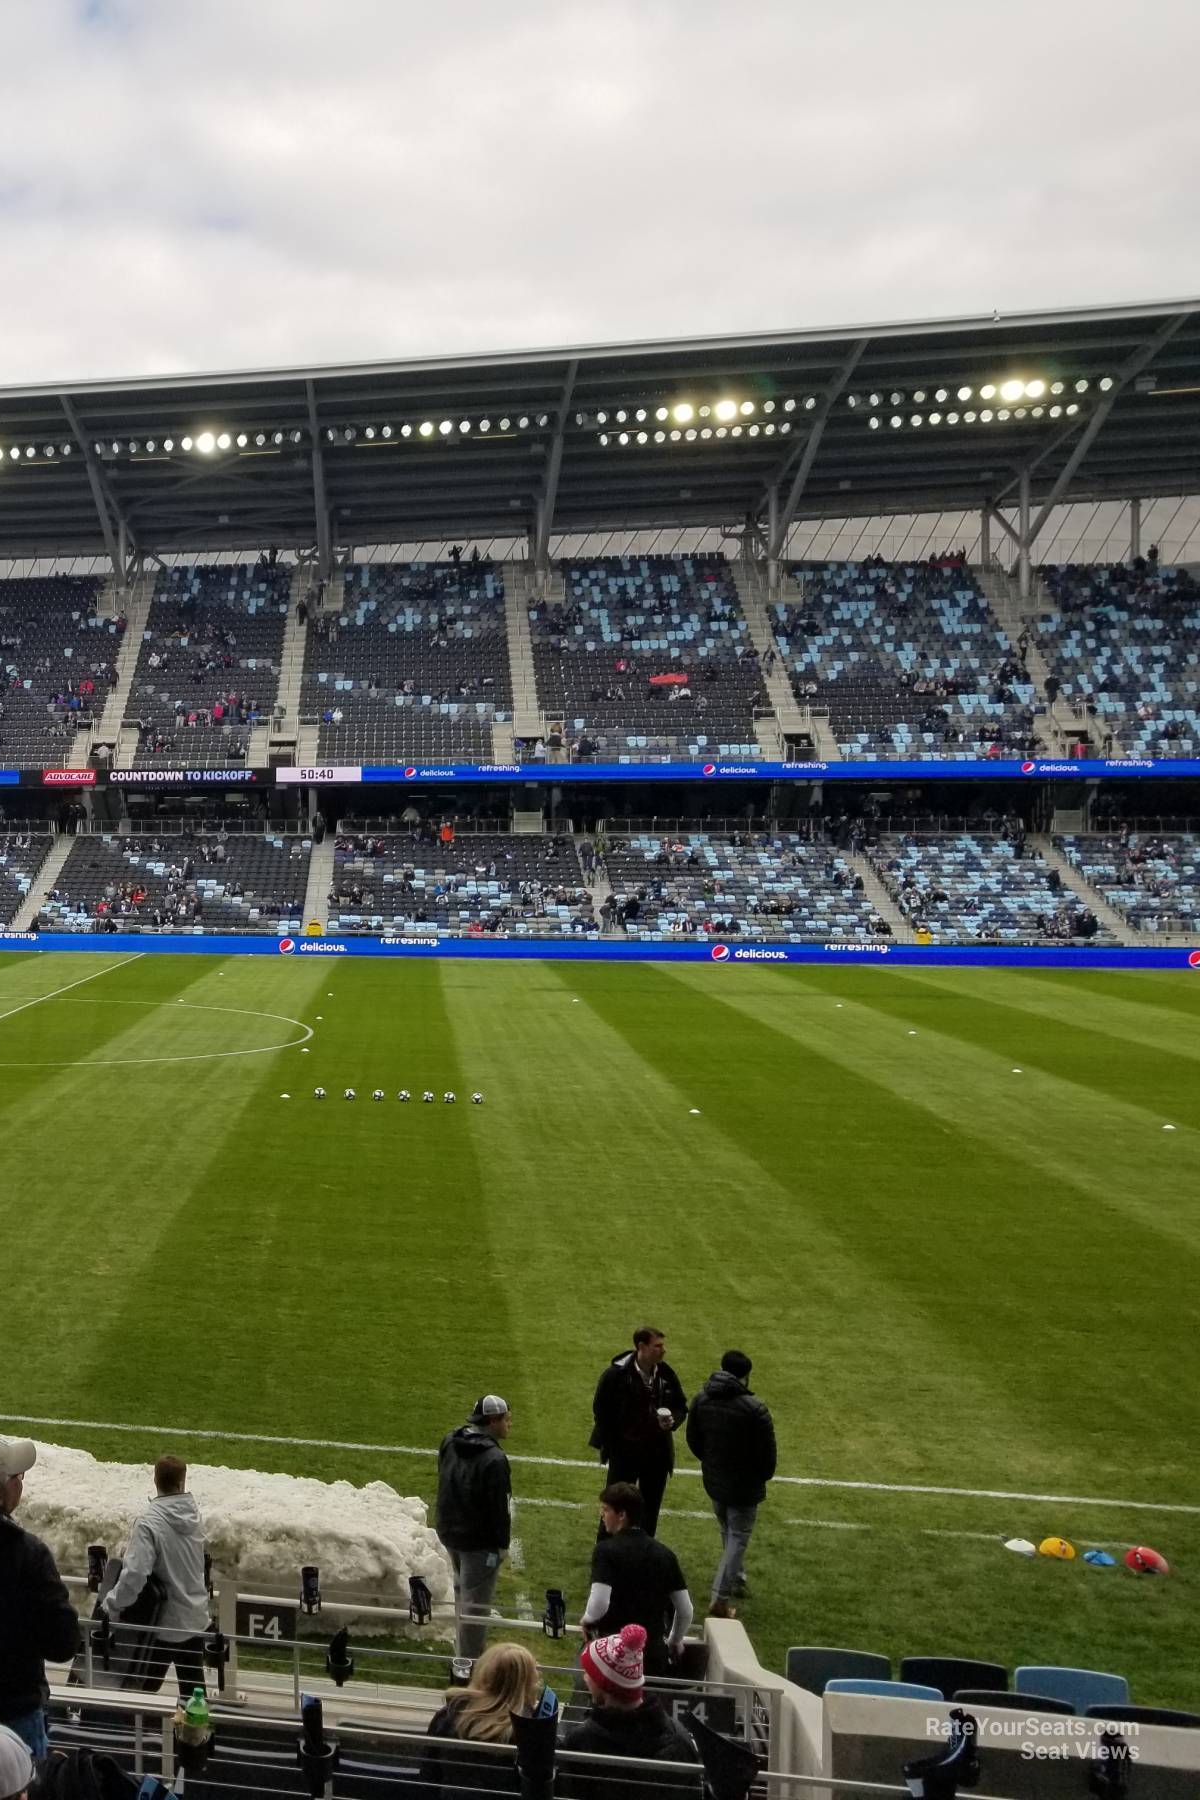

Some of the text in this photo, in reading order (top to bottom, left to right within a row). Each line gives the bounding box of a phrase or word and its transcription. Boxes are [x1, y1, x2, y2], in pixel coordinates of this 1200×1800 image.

[478, 764, 522, 773] refreshing.
[782, 762, 829, 770] refreshing.
[1039, 764, 1080, 772] delicious.
[1105, 760, 1155, 768] refreshing.
[300, 769, 334, 779] 50:40
[719, 766, 758, 774] delicious.
[44, 772, 94, 780] ADVOCARE
[109, 771, 183, 781] COUNTDOWN
[185, 771, 201, 780] TO
[300, 942, 348, 952] delicious.
[735, 948, 788, 959] delicious.
[249, 1614, 282, 1640] F4
[672, 1699, 709, 1725] F4
